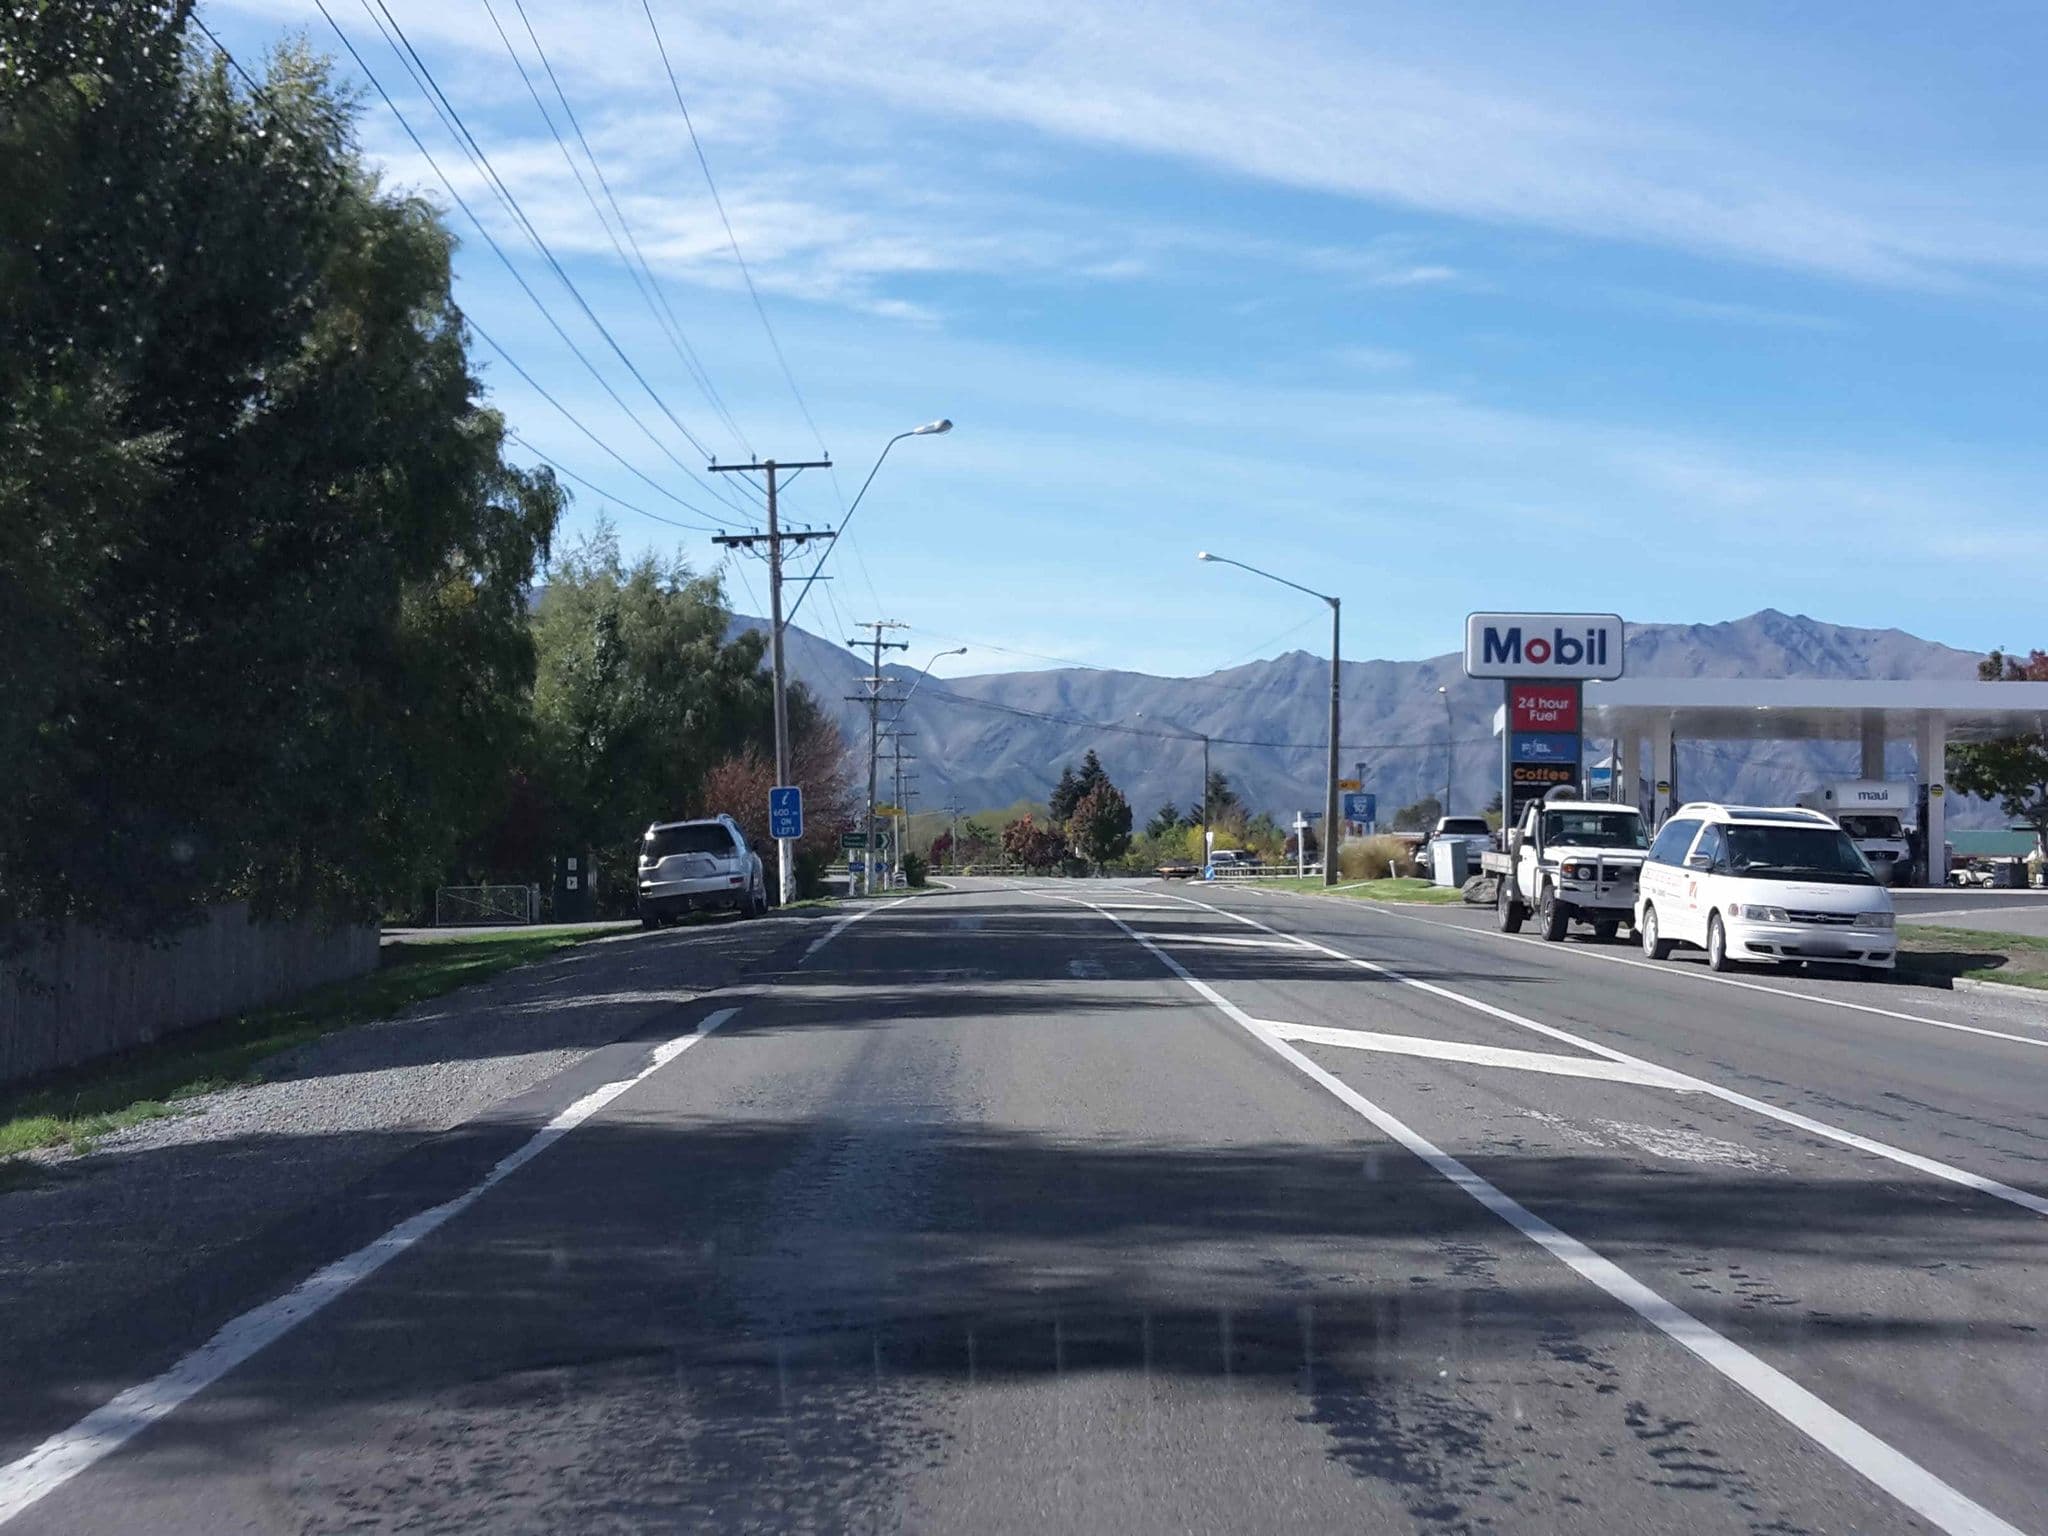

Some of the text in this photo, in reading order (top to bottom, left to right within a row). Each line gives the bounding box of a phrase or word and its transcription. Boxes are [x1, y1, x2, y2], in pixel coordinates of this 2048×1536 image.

[1483, 627, 1606, 665] Mobil
[1518, 697, 1568, 709] 24 hour
[1529, 710, 1557, 721] Fuel
[1514, 768, 1569, 781] Coffee
[1858, 789, 1888, 800] maui
